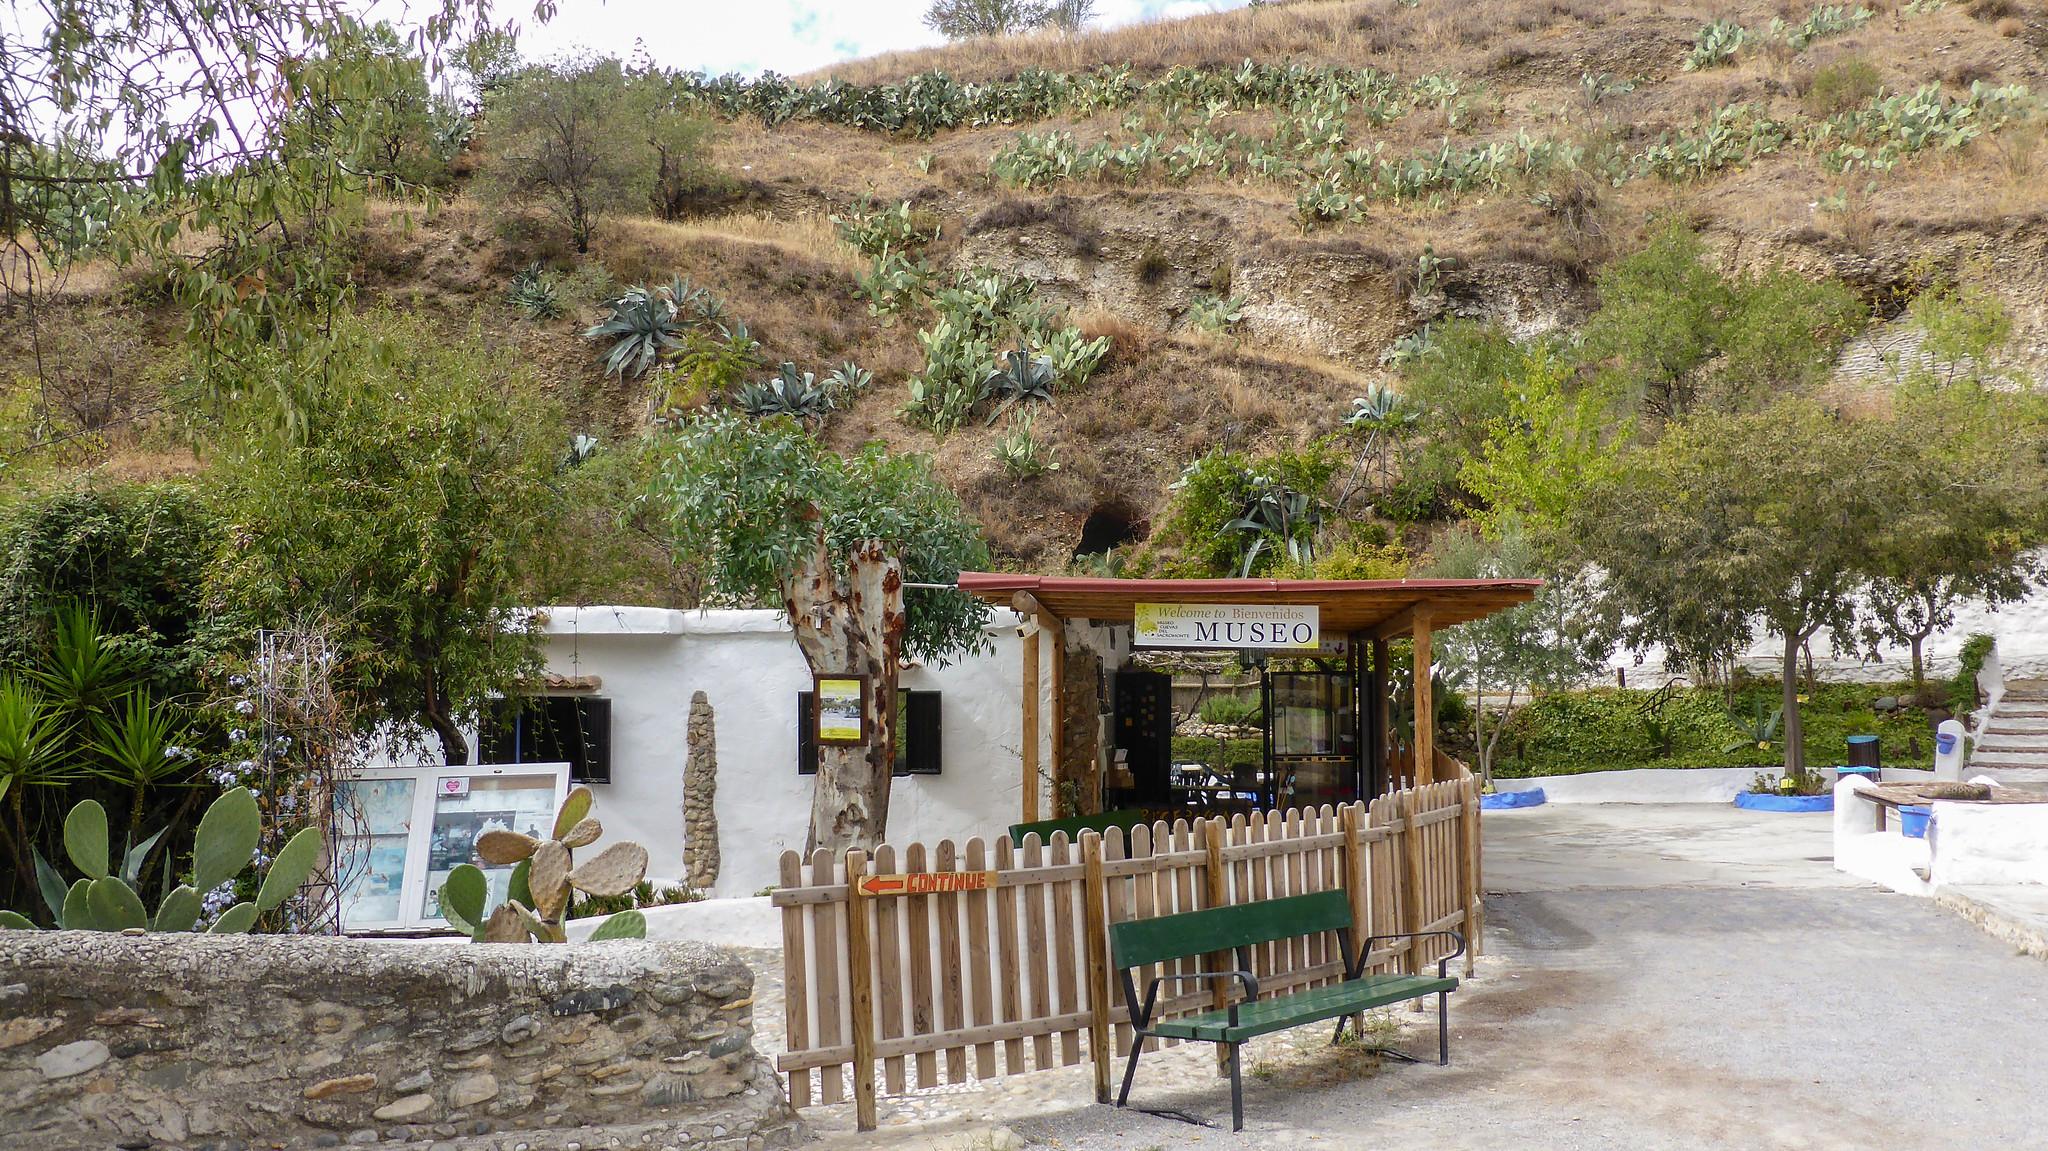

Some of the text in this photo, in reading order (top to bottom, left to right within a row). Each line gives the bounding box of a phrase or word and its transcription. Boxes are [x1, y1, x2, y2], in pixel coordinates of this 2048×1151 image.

[1159, 605, 1304, 620] Welcome to Bienvenidos
[1194, 621, 1312, 644] MUSEO
[907, 872, 985, 893] CONTINUE
